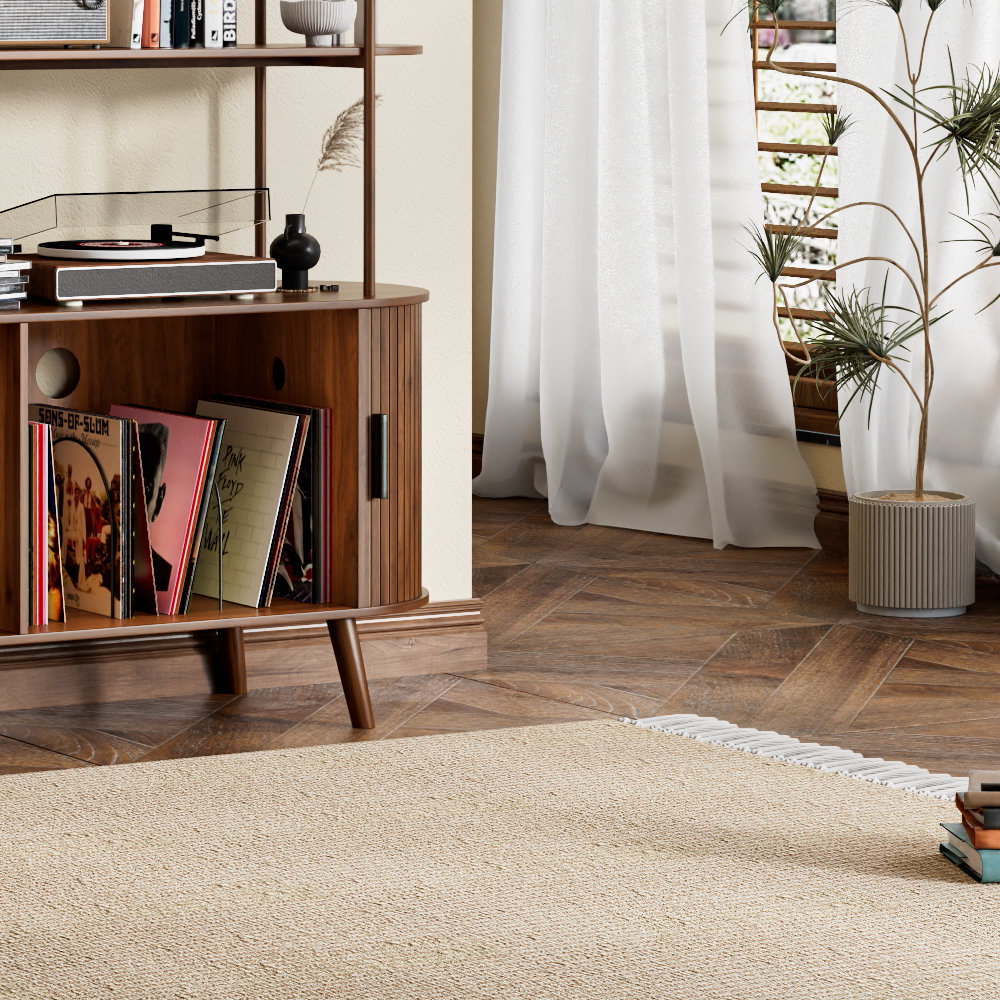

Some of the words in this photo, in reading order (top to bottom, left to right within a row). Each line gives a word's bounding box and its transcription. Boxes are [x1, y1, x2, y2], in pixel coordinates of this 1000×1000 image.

[38, 407, 110, 436] SONS-OF-SLUM
[222, 445, 246, 475] PINK
[216, 467, 244, 496] FLOYD
